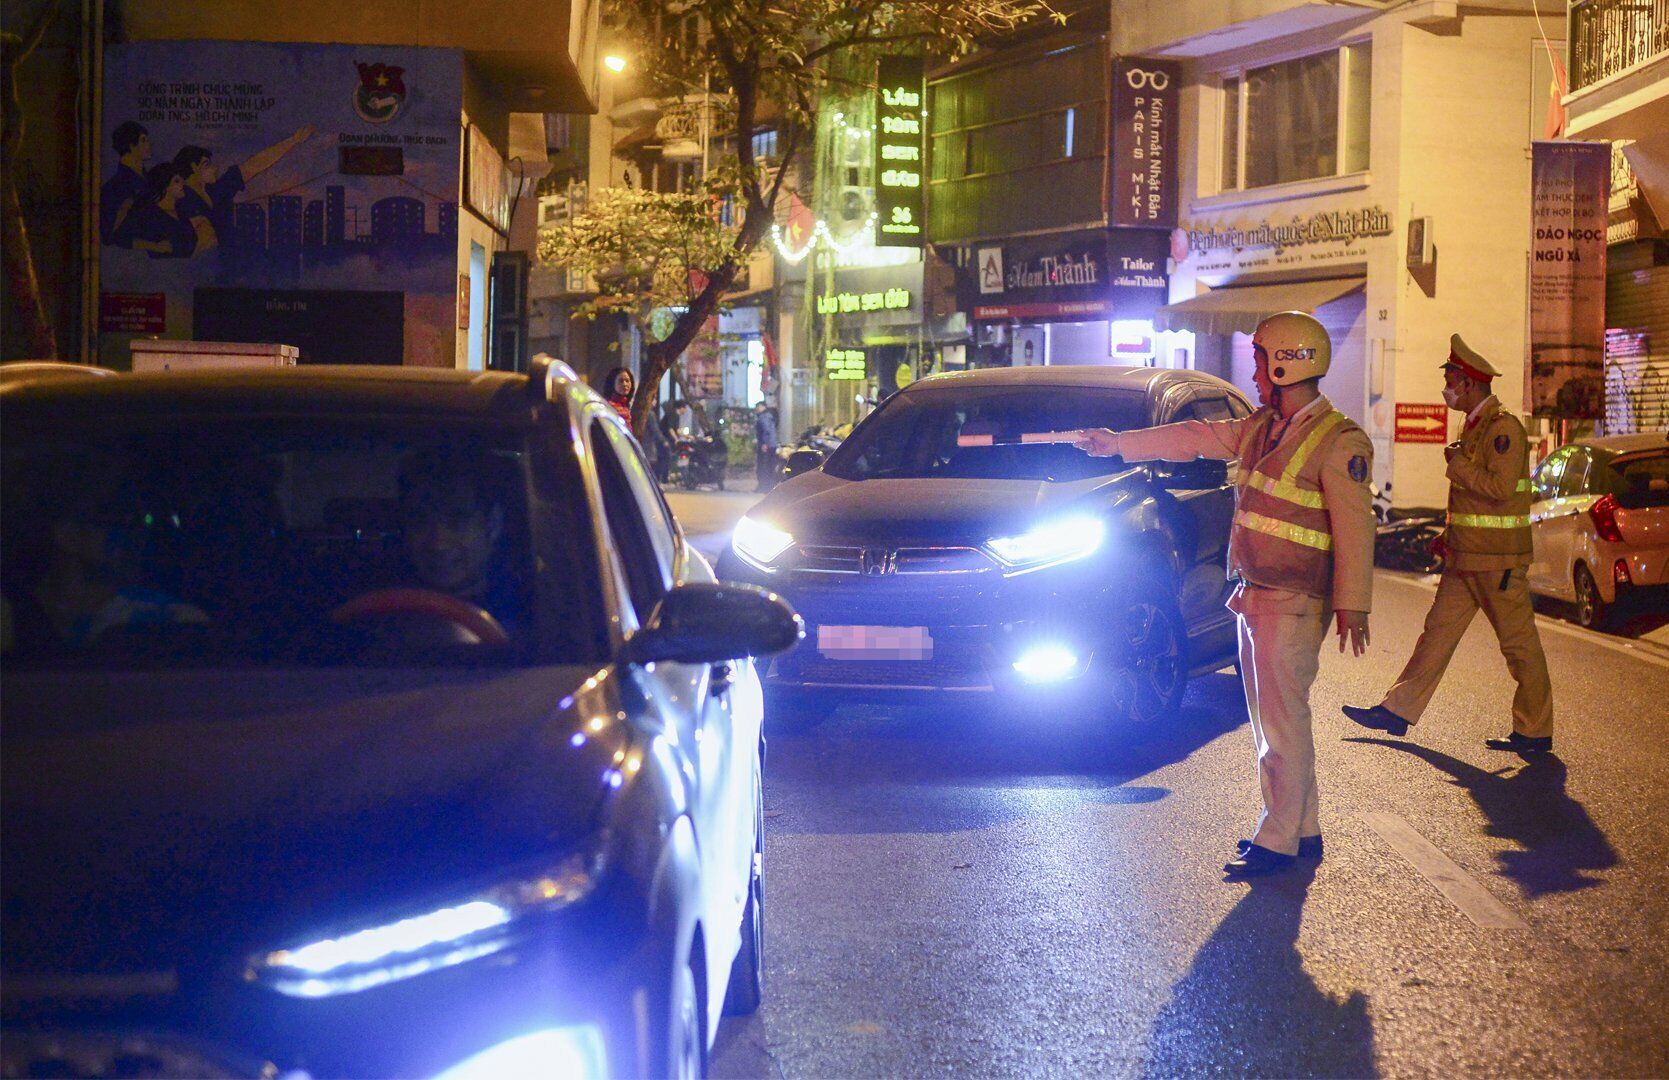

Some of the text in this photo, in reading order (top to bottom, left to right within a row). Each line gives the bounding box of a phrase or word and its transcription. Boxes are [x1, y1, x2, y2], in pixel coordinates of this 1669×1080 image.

[1151, 97, 1163, 128] Kính
[1131, 96, 1145, 219] PARIS MIKI
[1148, 159, 1162, 191] Nhật
[1148, 194, 1161, 219] Bản
[1567, 229, 1602, 244] NGỌC
[1536, 247, 1564, 261] NGŨ
[1120, 256, 1155, 271] Tailor
[1378, 309, 1389, 321] 32
[1275, 348, 1317, 361] CSGT
